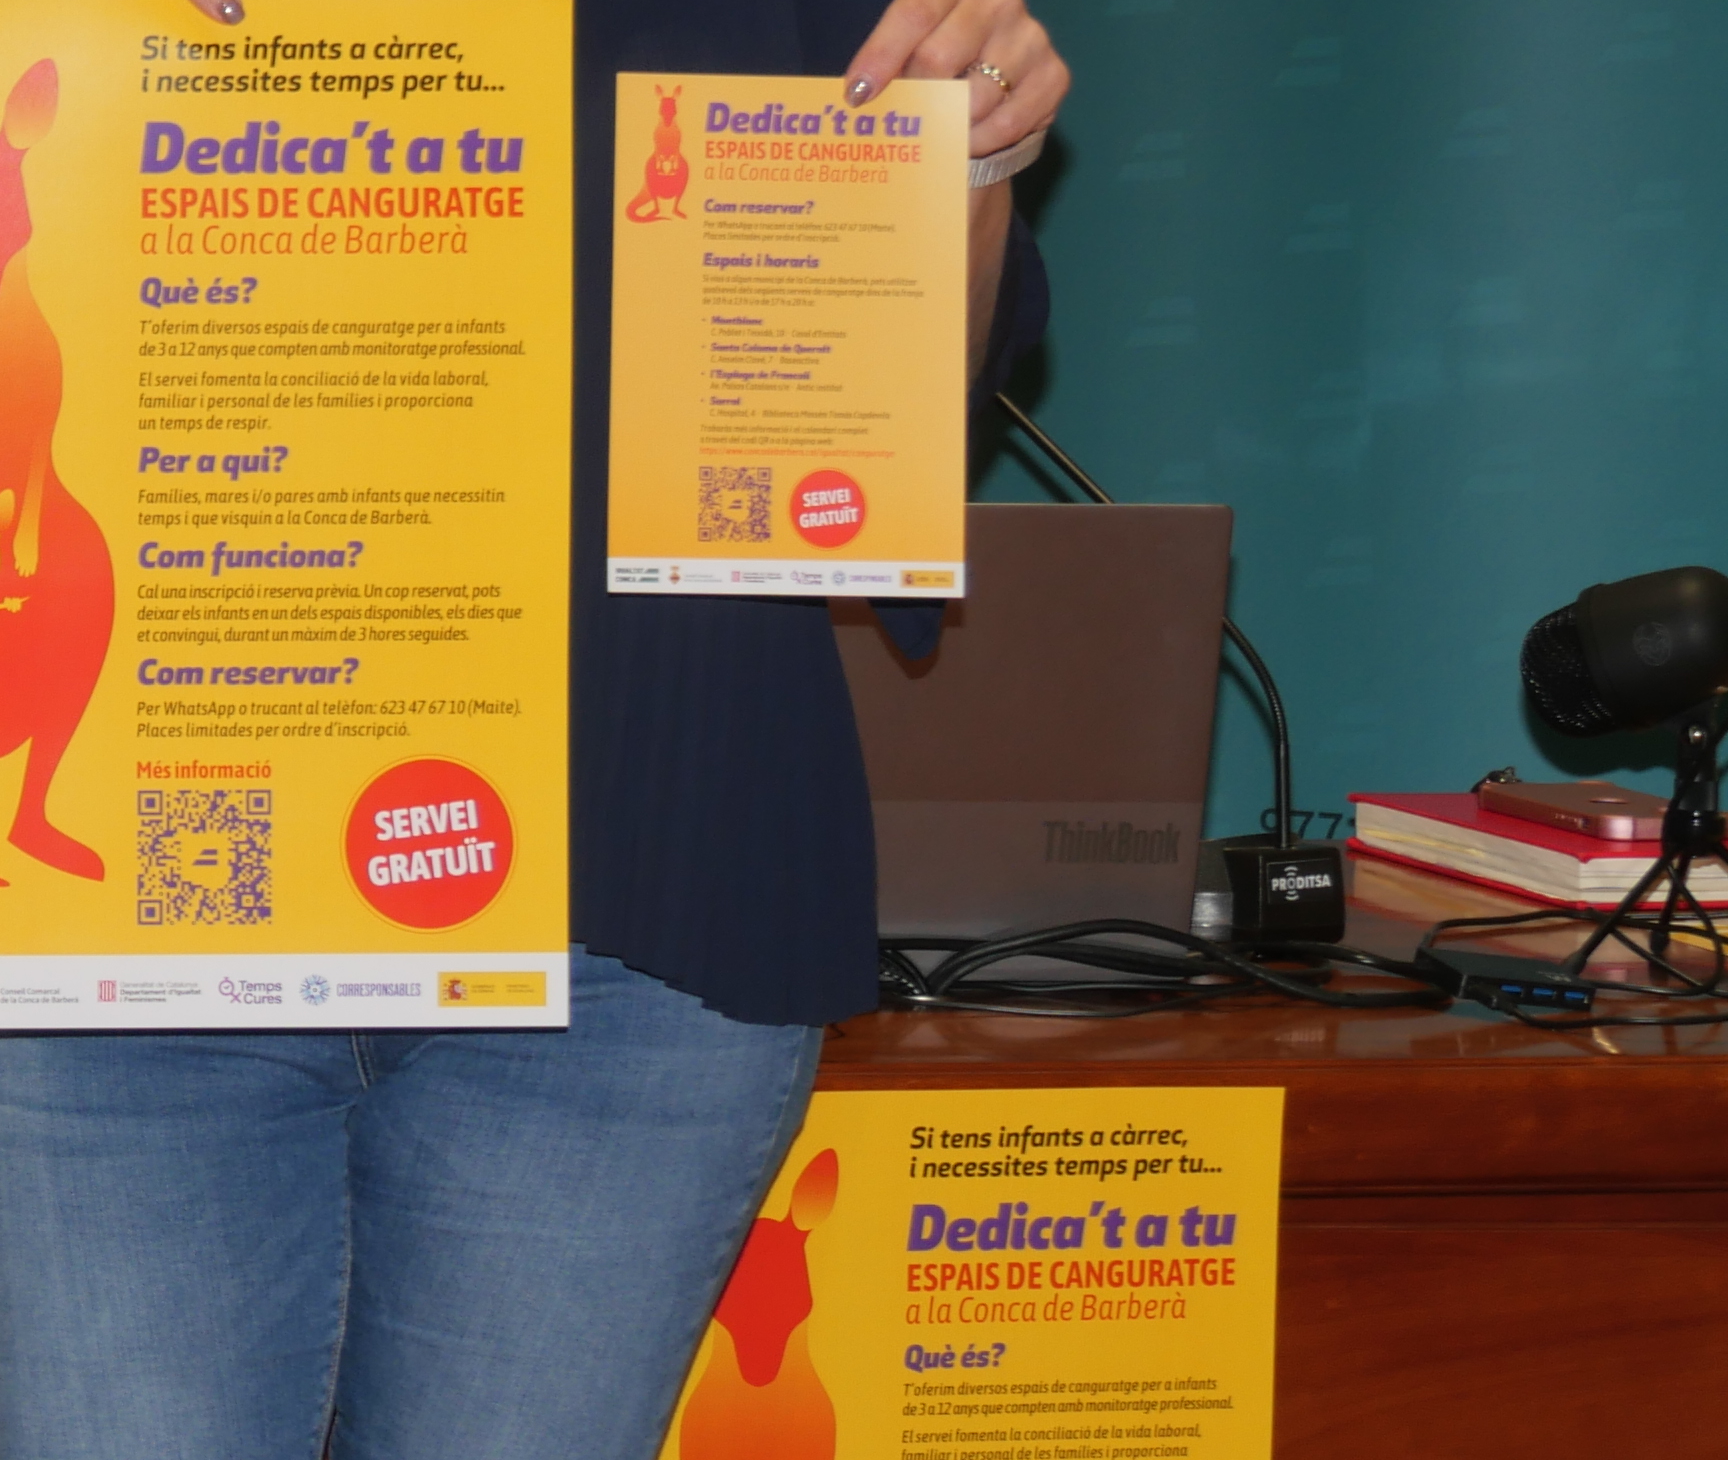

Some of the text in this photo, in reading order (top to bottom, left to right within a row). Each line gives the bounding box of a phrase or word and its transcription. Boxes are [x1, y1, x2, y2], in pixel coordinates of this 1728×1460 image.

[706, 102, 920, 137] Dedica't a tu
[141, 121, 523, 174] Dedica't a tu
[142, 187, 524, 218] ESPAIS DE CANGURATGE
[803, 489, 850, 507] SERVEI
[800, 506, 858, 528] GRATUÏT
[137, 760, 271, 779] Més informació
[375, 800, 477, 840] SERVEI
[369, 839, 495, 886] GRATUÏT
[1271, 873, 1332, 890] PRODITSA
[908, 1201, 1236, 1251] Dedica't a tu
[908, 1258, 1235, 1292] ESPAIS DE CANGURATGE
